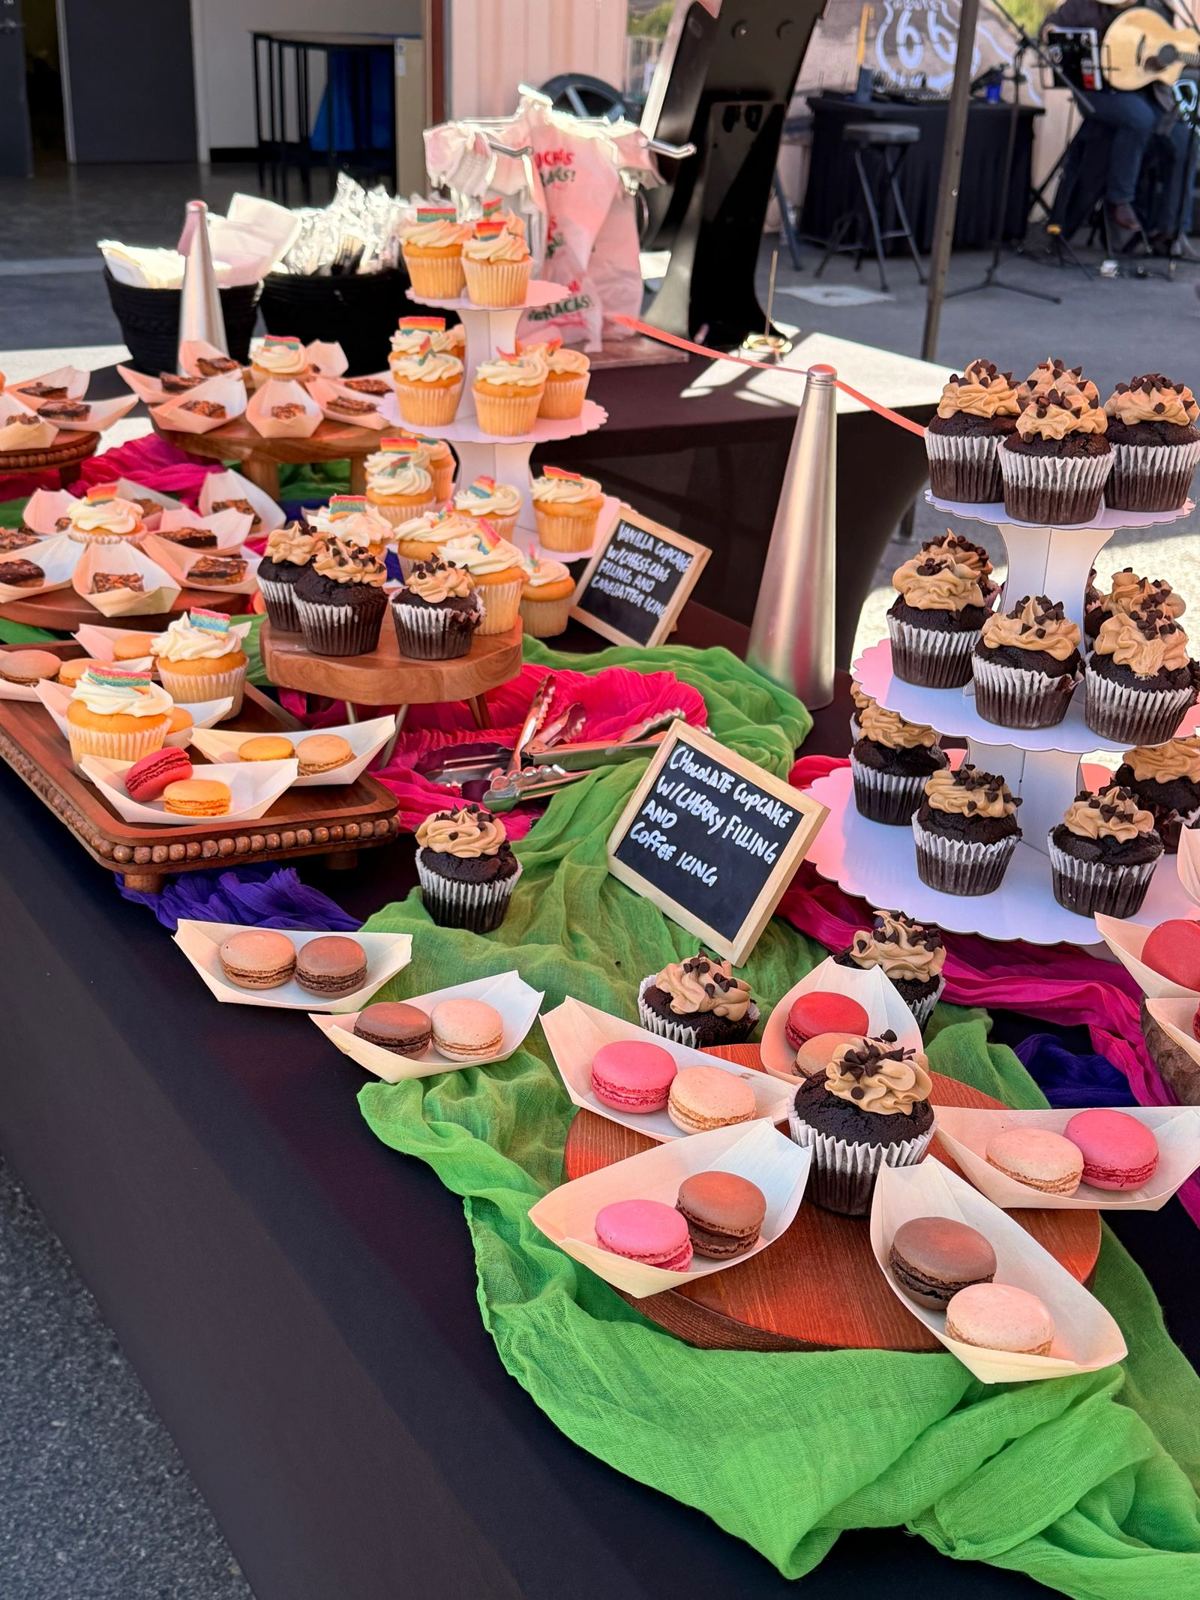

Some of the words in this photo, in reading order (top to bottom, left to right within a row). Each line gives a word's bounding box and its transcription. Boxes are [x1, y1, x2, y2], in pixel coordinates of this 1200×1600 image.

[896, 7, 958, 69] 66
[598, 559, 632, 583] FILLING
[632, 574, 656, 592] AND
[642, 800, 677, 829] AND
[722, 816, 779, 865] FILLING
[676, 852, 717, 887] ICING
